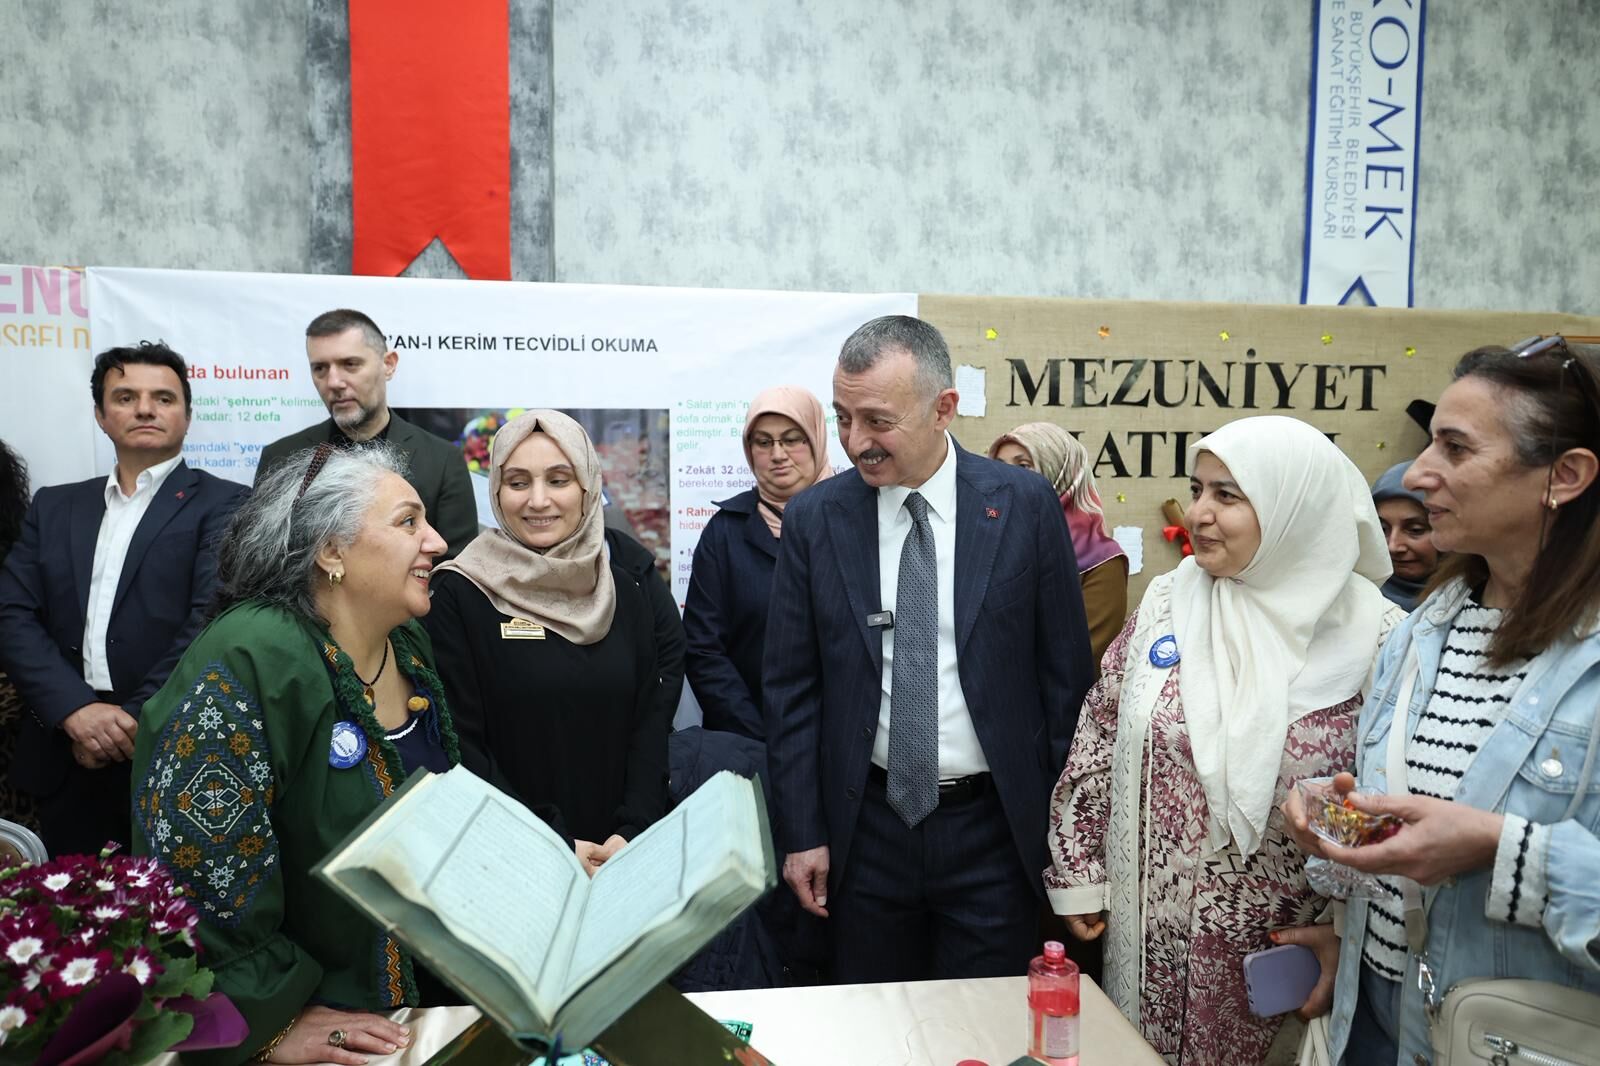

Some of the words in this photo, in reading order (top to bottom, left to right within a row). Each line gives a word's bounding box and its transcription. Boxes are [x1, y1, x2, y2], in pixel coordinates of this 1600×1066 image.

[1330, 16, 1345, 79] SANAT
[1346, 11, 1364, 128] BÜYÜKŞEHİR
[1365, 0, 1412, 240] O-MEK
[1323, 155, 1340, 239] KURSLARI
[383, 335, 432, 350] 'AN-I
[438, 333, 497, 350] KERİM
[503, 334, 585, 352] TECVİDLİ
[591, 338, 659, 352] OKUMA
[214, 365, 289, 380] bulunan
[1004, 348, 1387, 412] MEZUNİYET
[715, 400, 736, 411] yani
[238, 411, 251, 422] 12
[254, 411, 281, 422] defa
[676, 414, 699, 423] defa
[702, 414, 732, 423] olmak
[721, 465, 733, 474] 32
[679, 479, 723, 488] berekete
